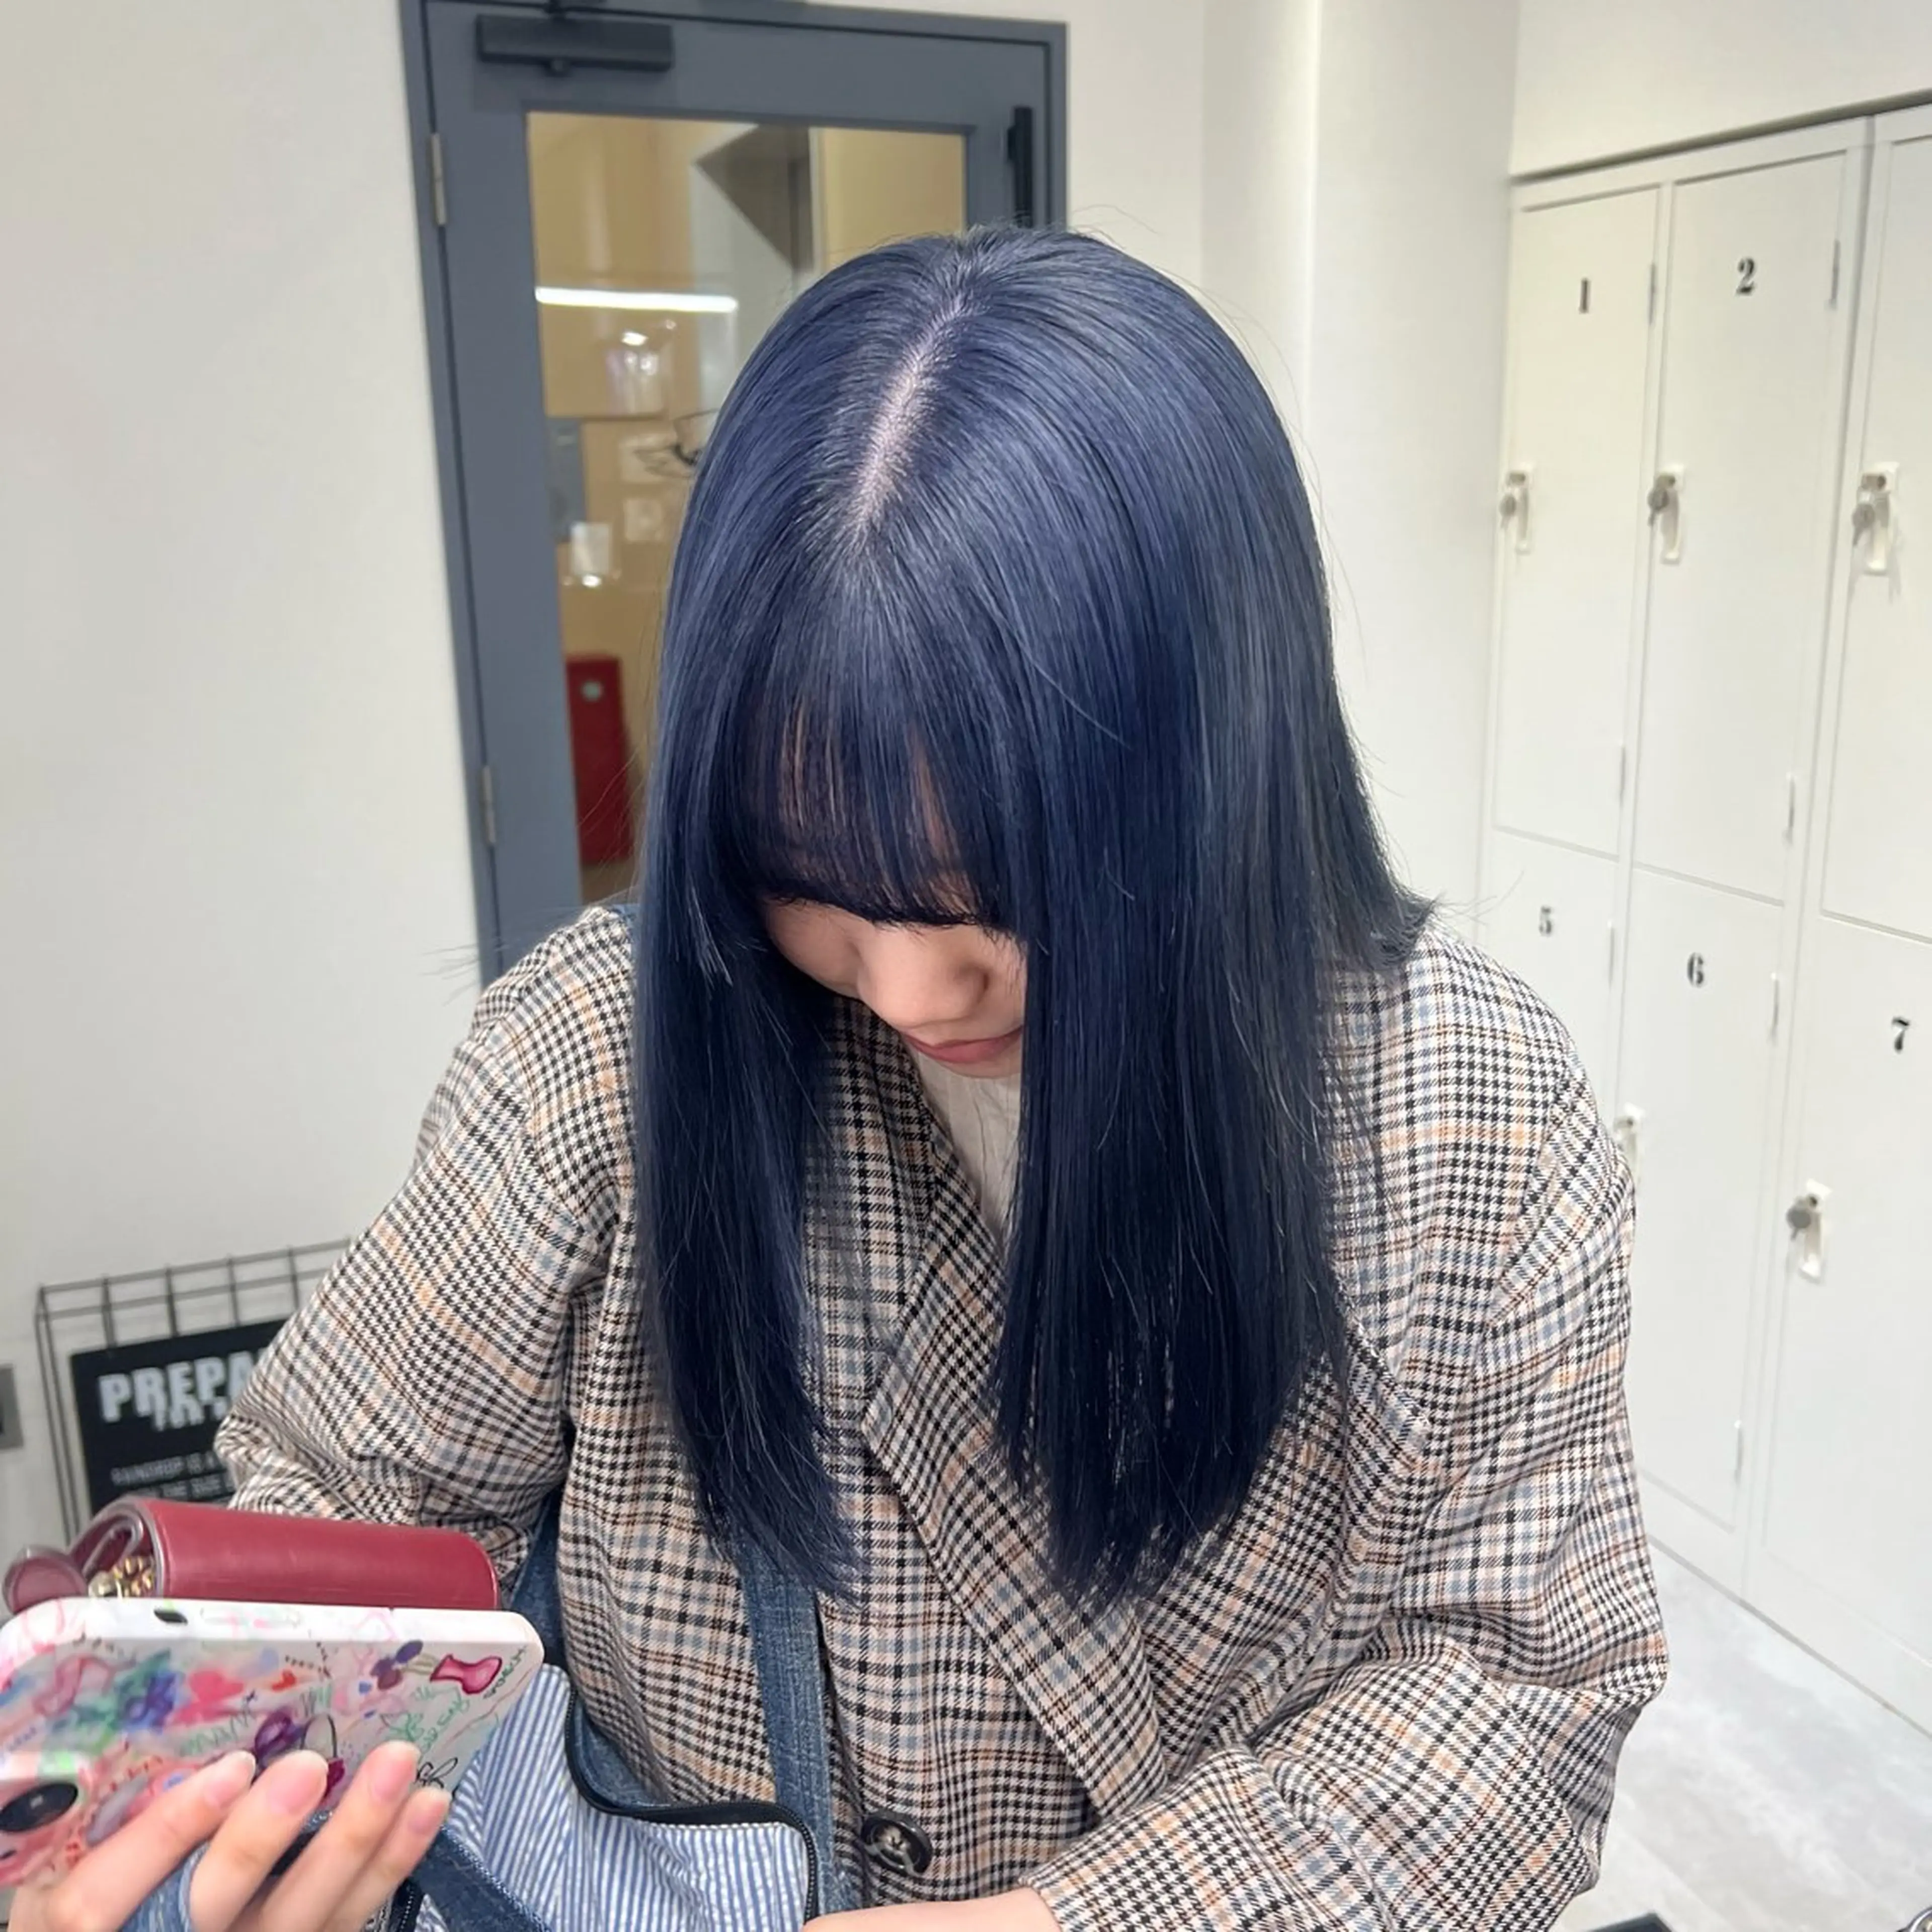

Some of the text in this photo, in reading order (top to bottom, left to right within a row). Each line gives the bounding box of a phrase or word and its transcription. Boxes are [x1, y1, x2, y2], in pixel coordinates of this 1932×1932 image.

[1735, 257, 1756, 296] 2
[1579, 278, 1590, 313] 1
[1538, 906, 1553, 935] 5
[1685, 952, 1705, 988] 6
[1890, 1016, 1911, 1054] 7
[98, 1348, 261, 1423] PREPA
